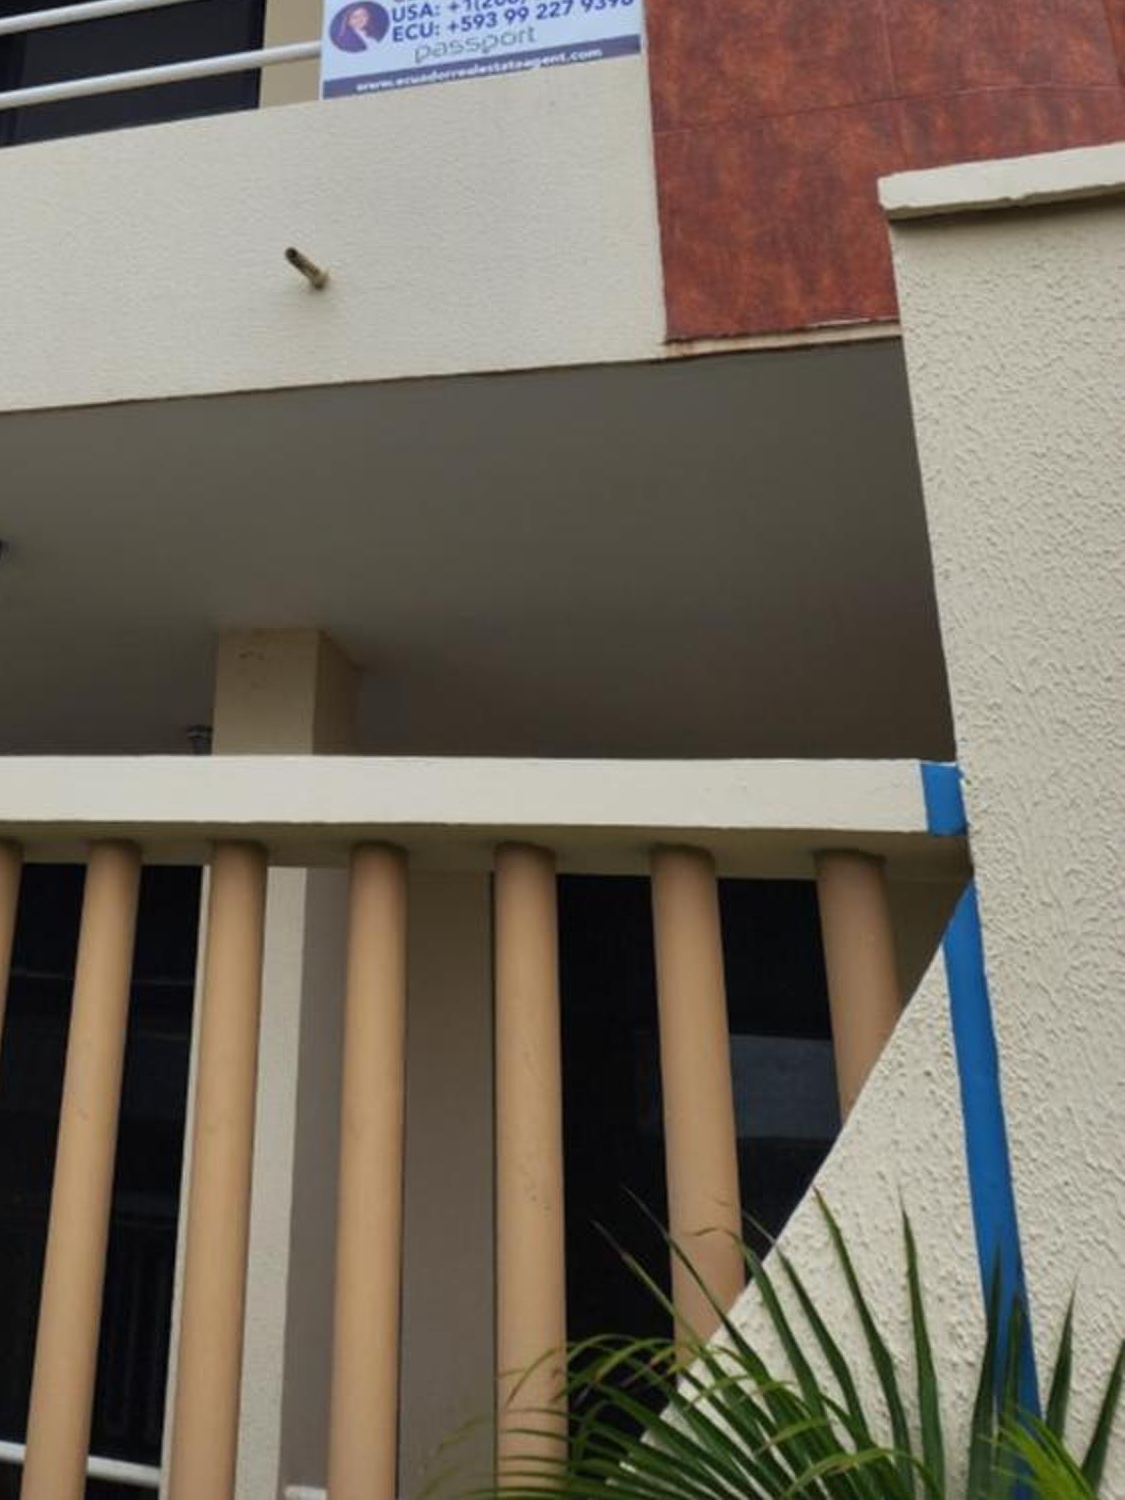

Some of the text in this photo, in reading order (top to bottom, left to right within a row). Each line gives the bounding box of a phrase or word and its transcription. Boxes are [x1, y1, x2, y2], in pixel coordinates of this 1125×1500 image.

[392, 4, 441, 23] USA:
[392, 24, 441, 43] ECU:
[449, 9, 499, 34] +593
[504, 6, 530, 26] 99
[536, 0, 573, 20] 227
[414, 26, 536, 64] passport
